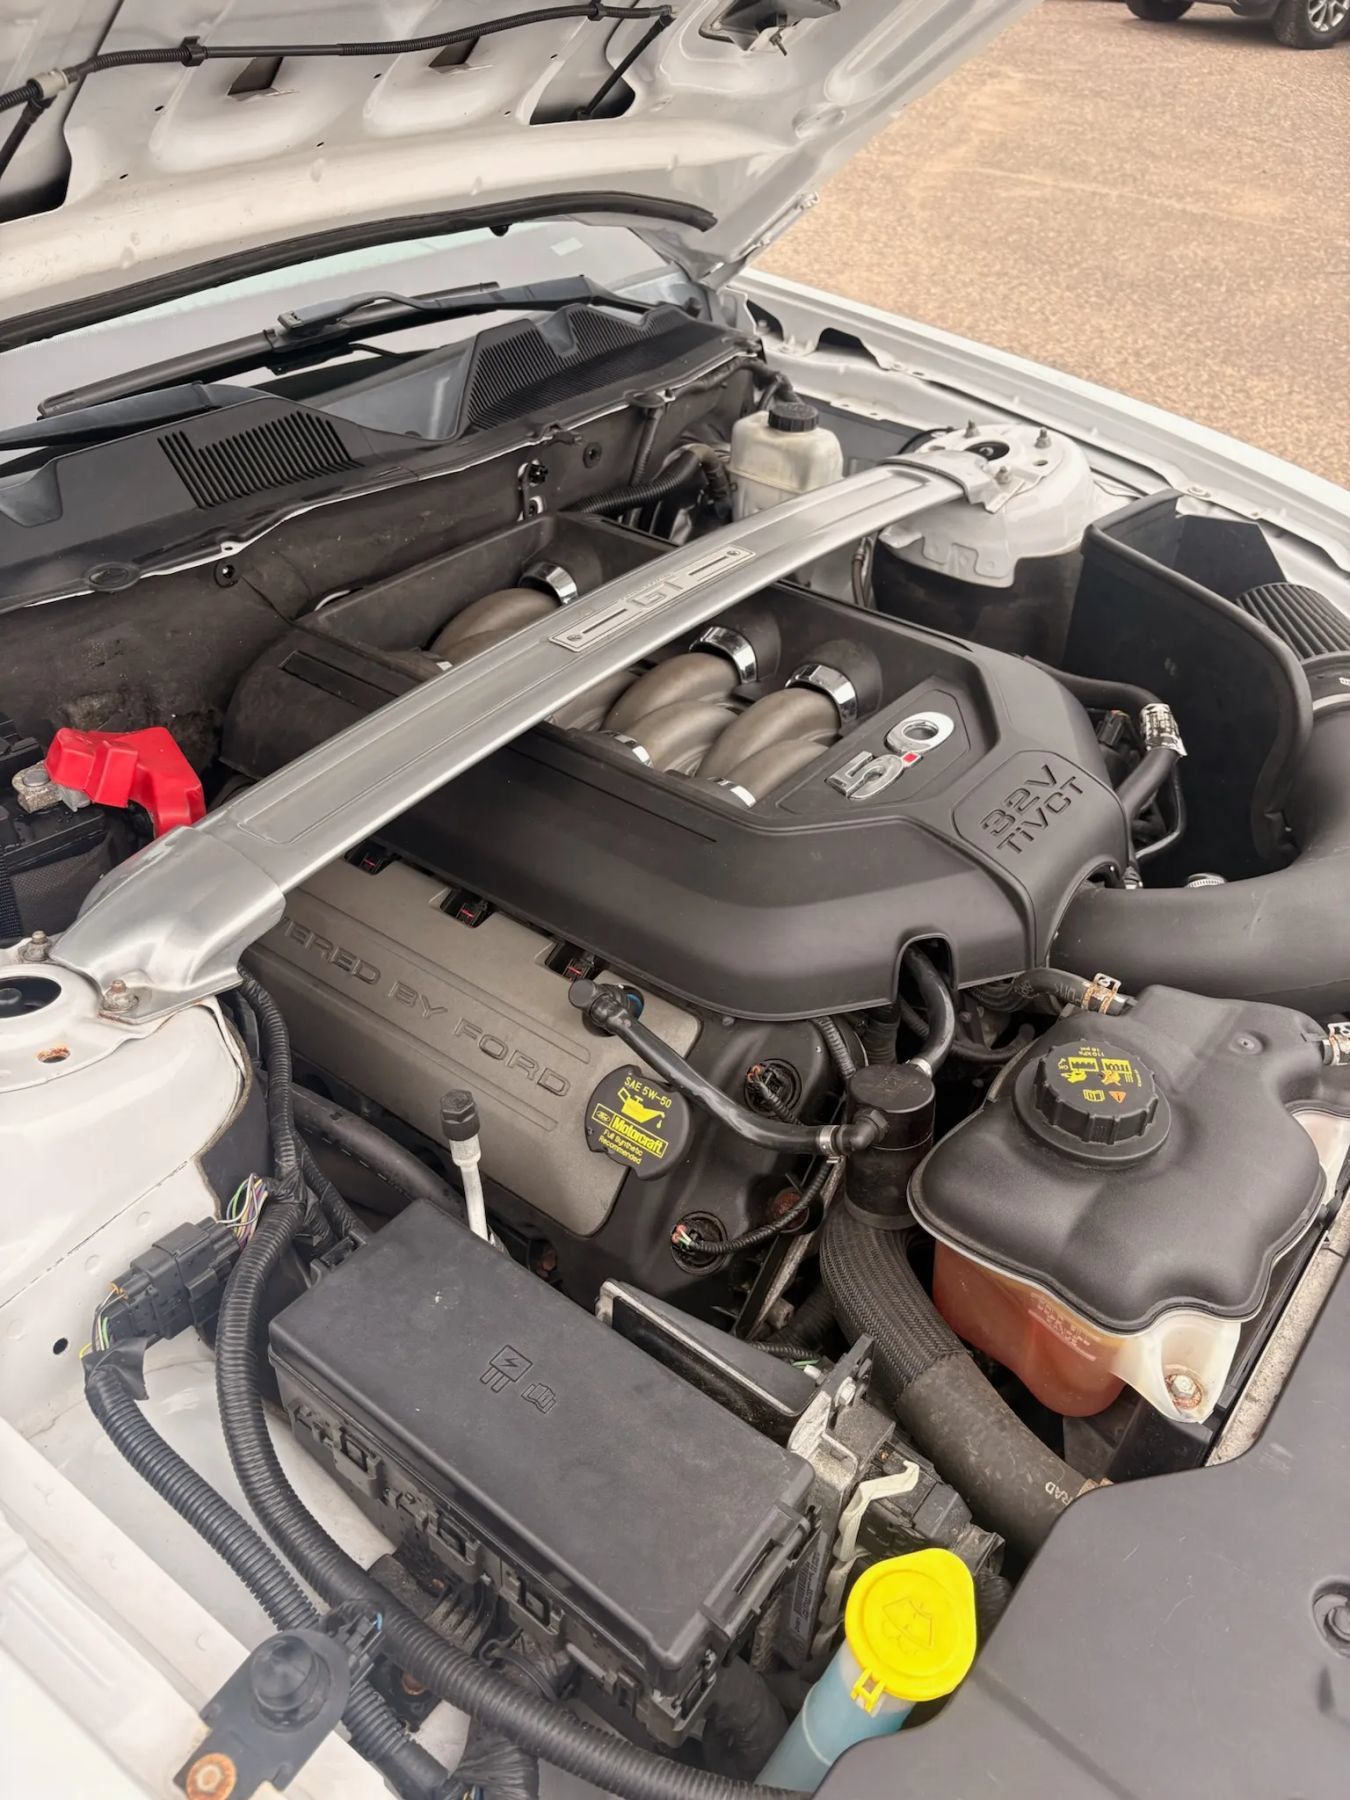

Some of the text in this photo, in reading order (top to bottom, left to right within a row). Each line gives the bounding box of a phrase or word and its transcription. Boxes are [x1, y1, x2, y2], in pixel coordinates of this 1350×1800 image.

[824, 711, 955, 801] 5.0
[979, 764, 1059, 836] 32V
[997, 776, 1084, 855] TiVCT
[283, 918, 571, 1097] ERED BY FORD
[624, 1077, 672, 1108] SAE 5W-50
[598, 1136, 642, 1164] Recommended
[603, 1129, 644, 1157] Full Synthetic
[611, 1116, 664, 1154] Motorcraft
[1045, 1481, 1074, 1505] RAD
